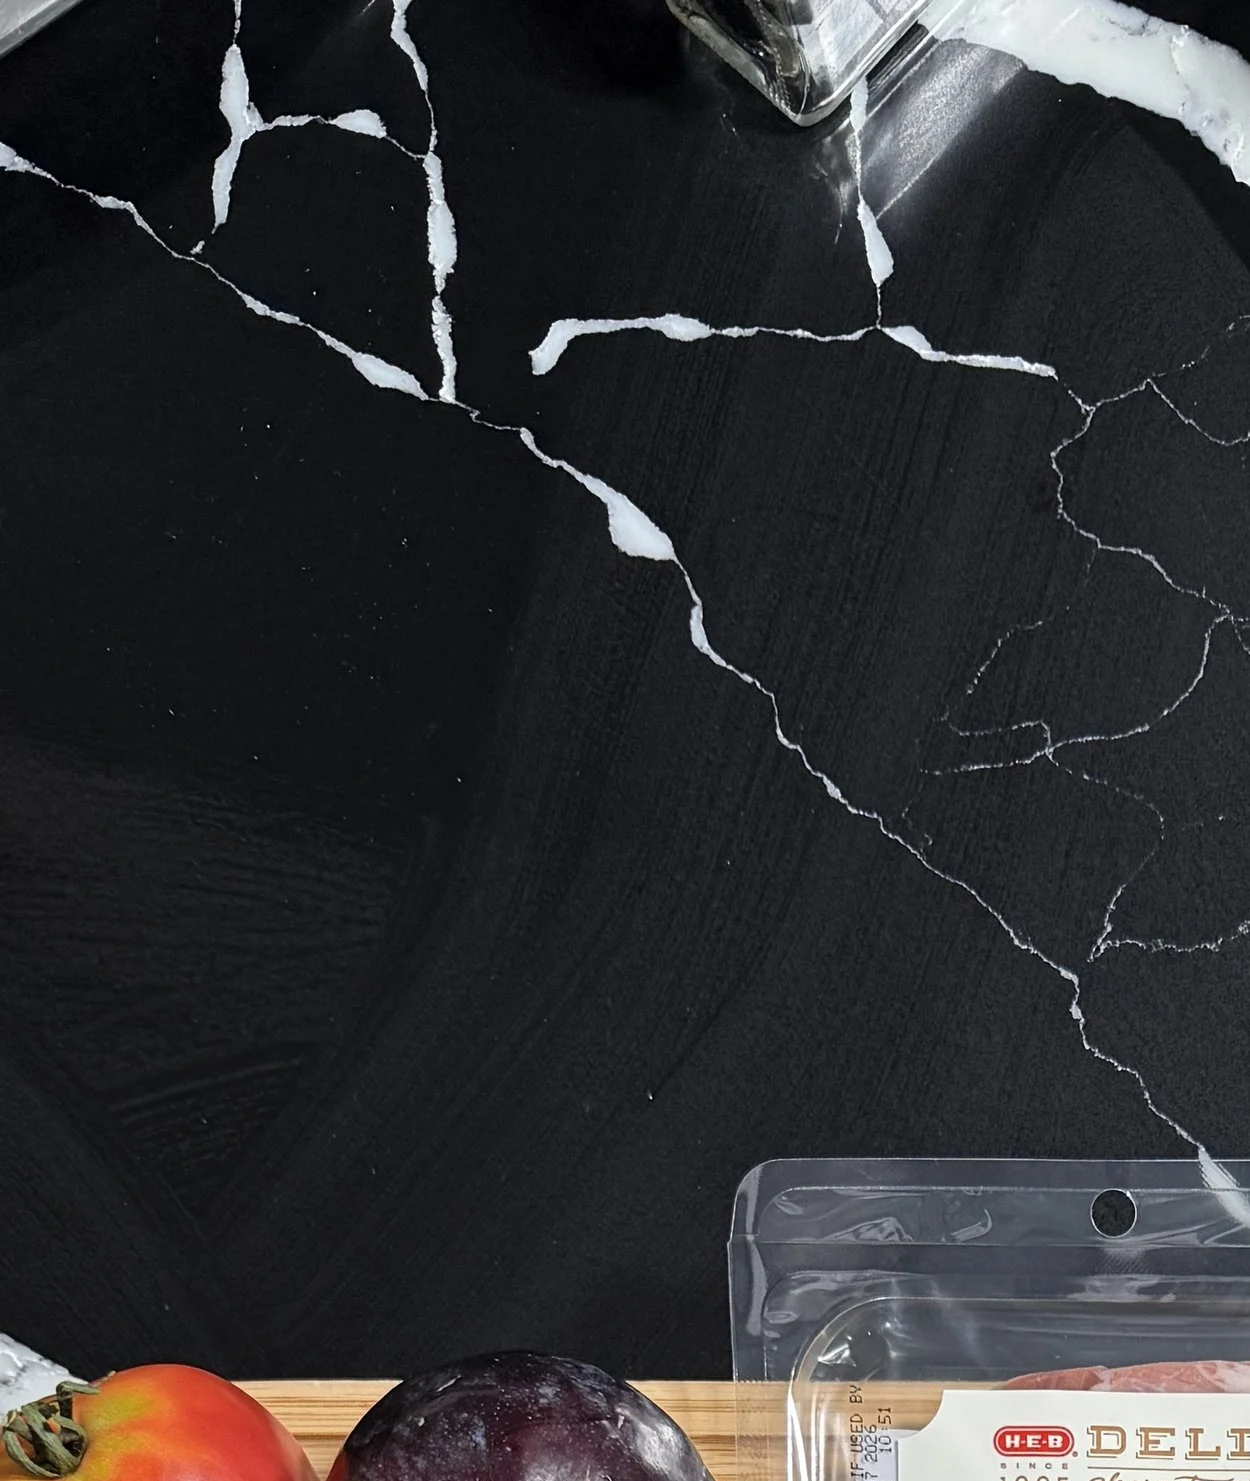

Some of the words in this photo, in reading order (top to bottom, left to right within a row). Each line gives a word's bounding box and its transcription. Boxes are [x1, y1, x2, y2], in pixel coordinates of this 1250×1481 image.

[849, 1384, 862, 1404] BY
[849, 1413, 863, 1453] USED
[864, 1424, 877, 1462] 2026
[850, 1461, 863, 1478] IF
[1001, 1462, 1069, 1470] SINCE
